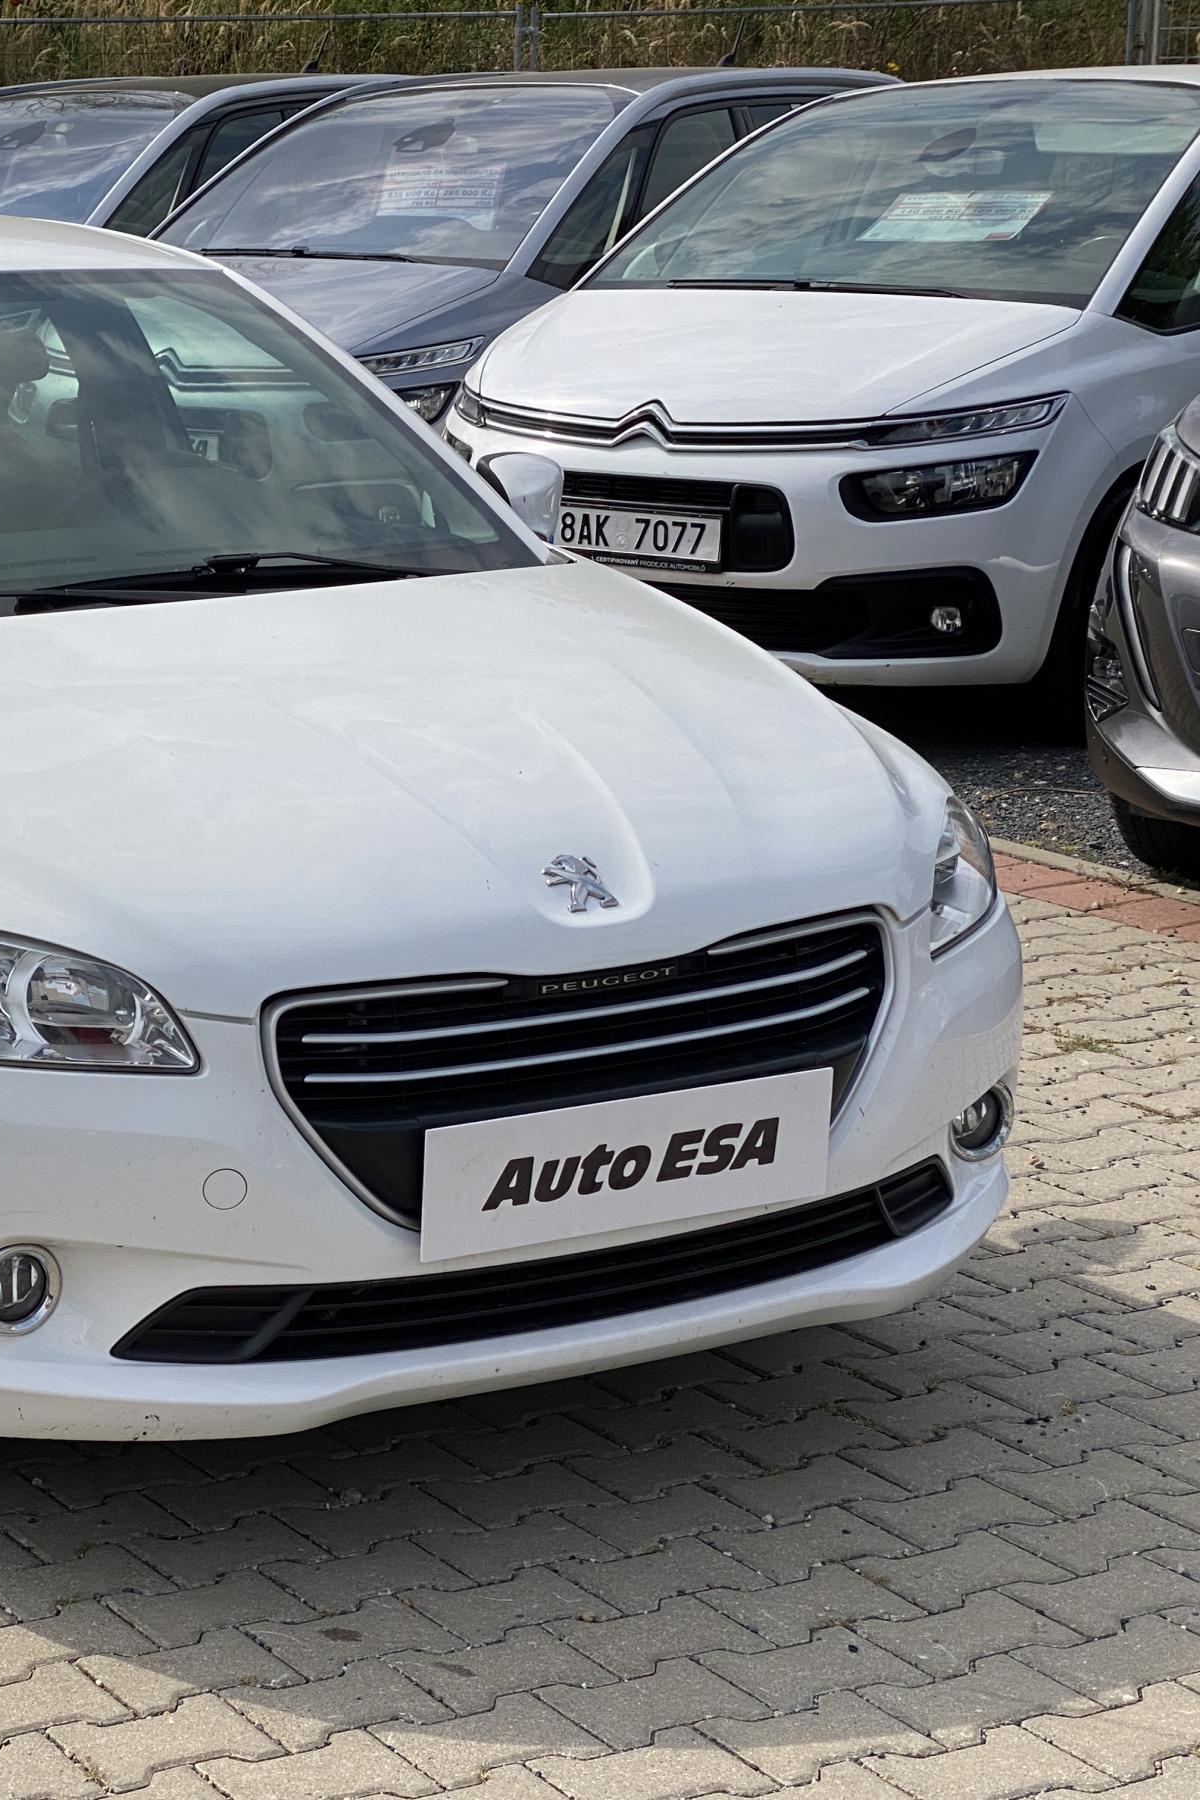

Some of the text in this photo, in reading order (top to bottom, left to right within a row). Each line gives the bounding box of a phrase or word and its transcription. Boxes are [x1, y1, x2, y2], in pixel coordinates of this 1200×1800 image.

[560, 511, 706, 554] 8AK 7077
[596, 556, 639, 566] CERTIFIKOVANÝ
[640, 560, 669, 569] PRODEJCE
[541, 966, 675, 994] PEUGEOT
[481, 1116, 780, 1212] Auto ESA
